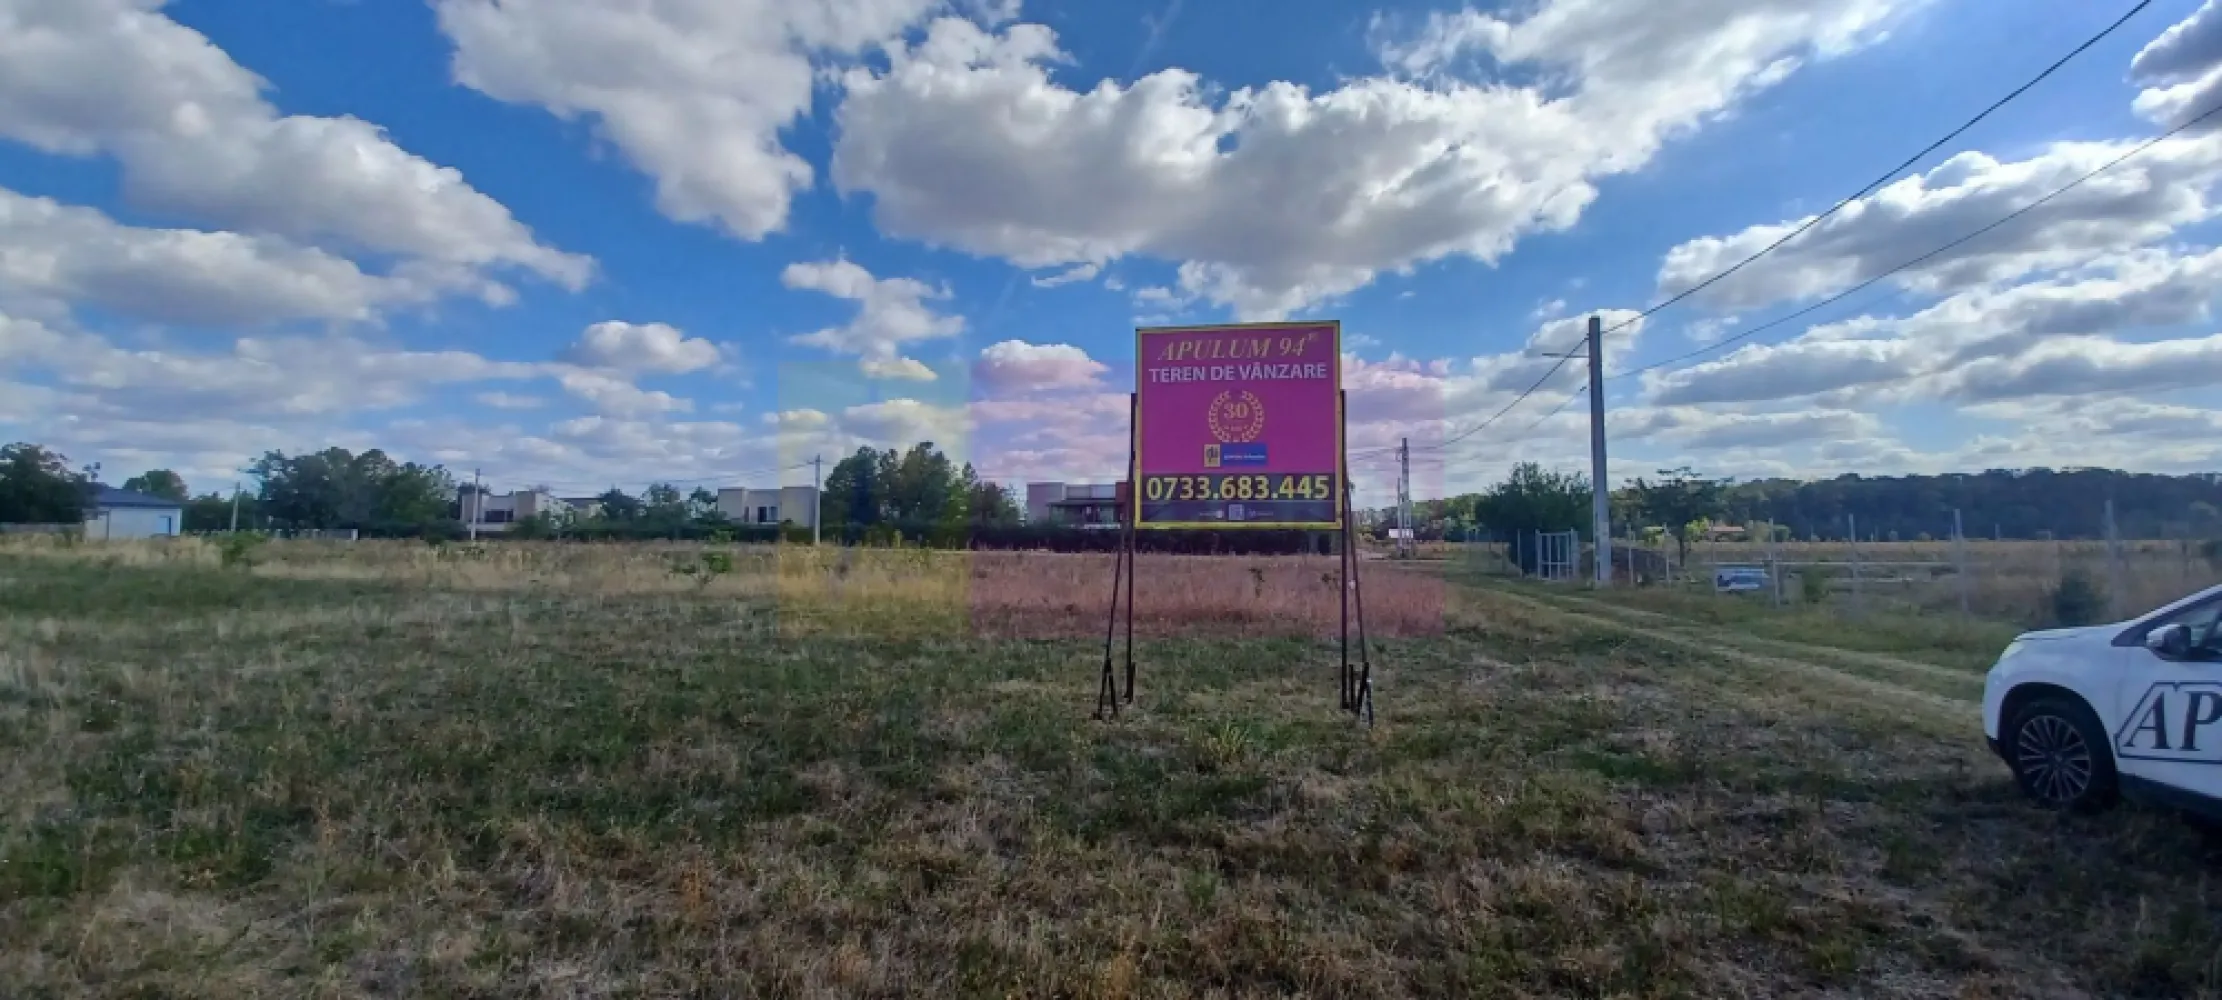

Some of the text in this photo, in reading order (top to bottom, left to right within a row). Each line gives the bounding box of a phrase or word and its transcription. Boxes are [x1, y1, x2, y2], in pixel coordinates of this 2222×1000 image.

[1157, 337, 1271, 361] APULUM
[1149, 362, 1328, 383] TEREN DE VÂNZARE
[1223, 402, 1249, 419] 30
[1146, 475, 1330, 500] 0733.683.445
